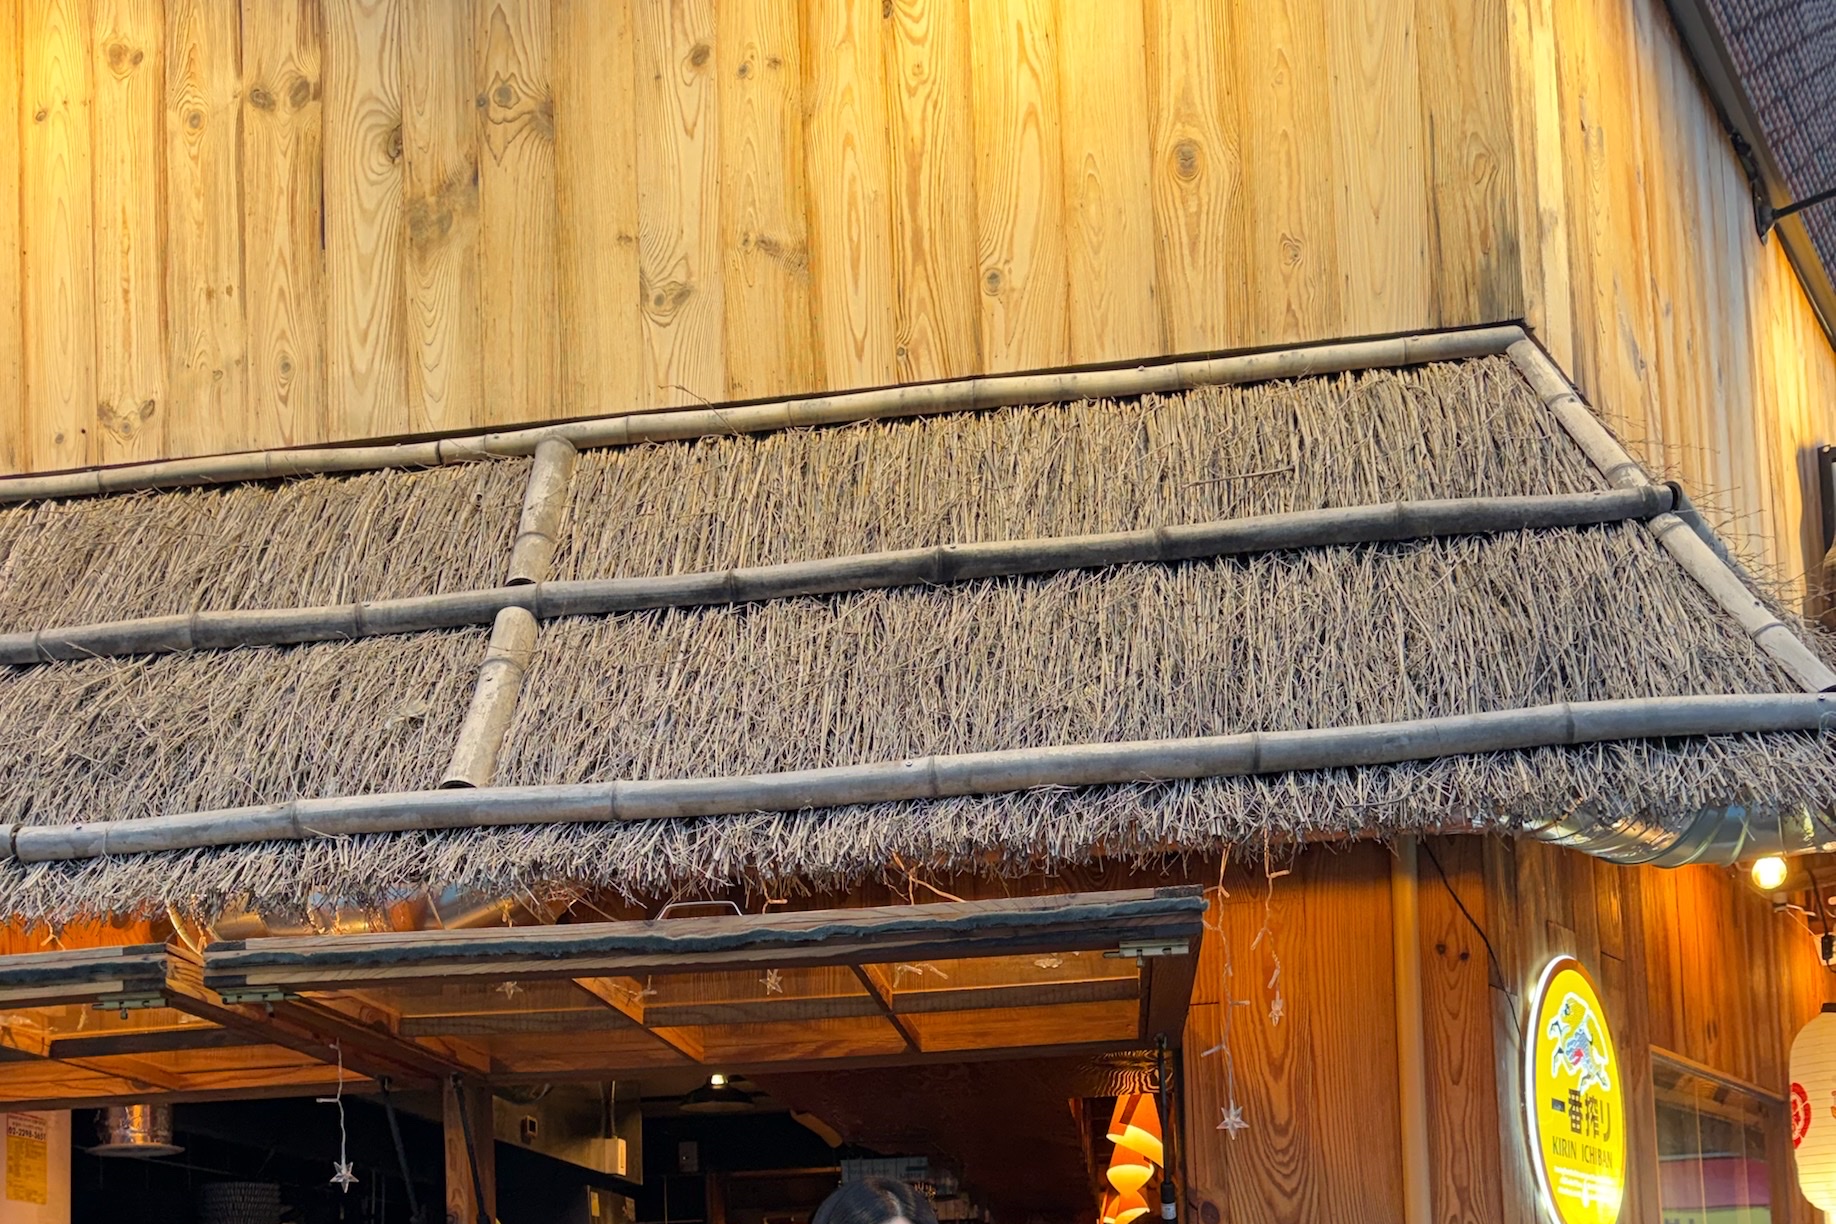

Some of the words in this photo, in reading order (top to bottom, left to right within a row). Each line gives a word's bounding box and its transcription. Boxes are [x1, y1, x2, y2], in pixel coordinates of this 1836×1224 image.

[1551, 1088, 1611, 1142] 一番搾り
[1552, 1135, 1577, 1160] KIRIN
[1581, 1143, 1613, 1169] ICHIBAN
